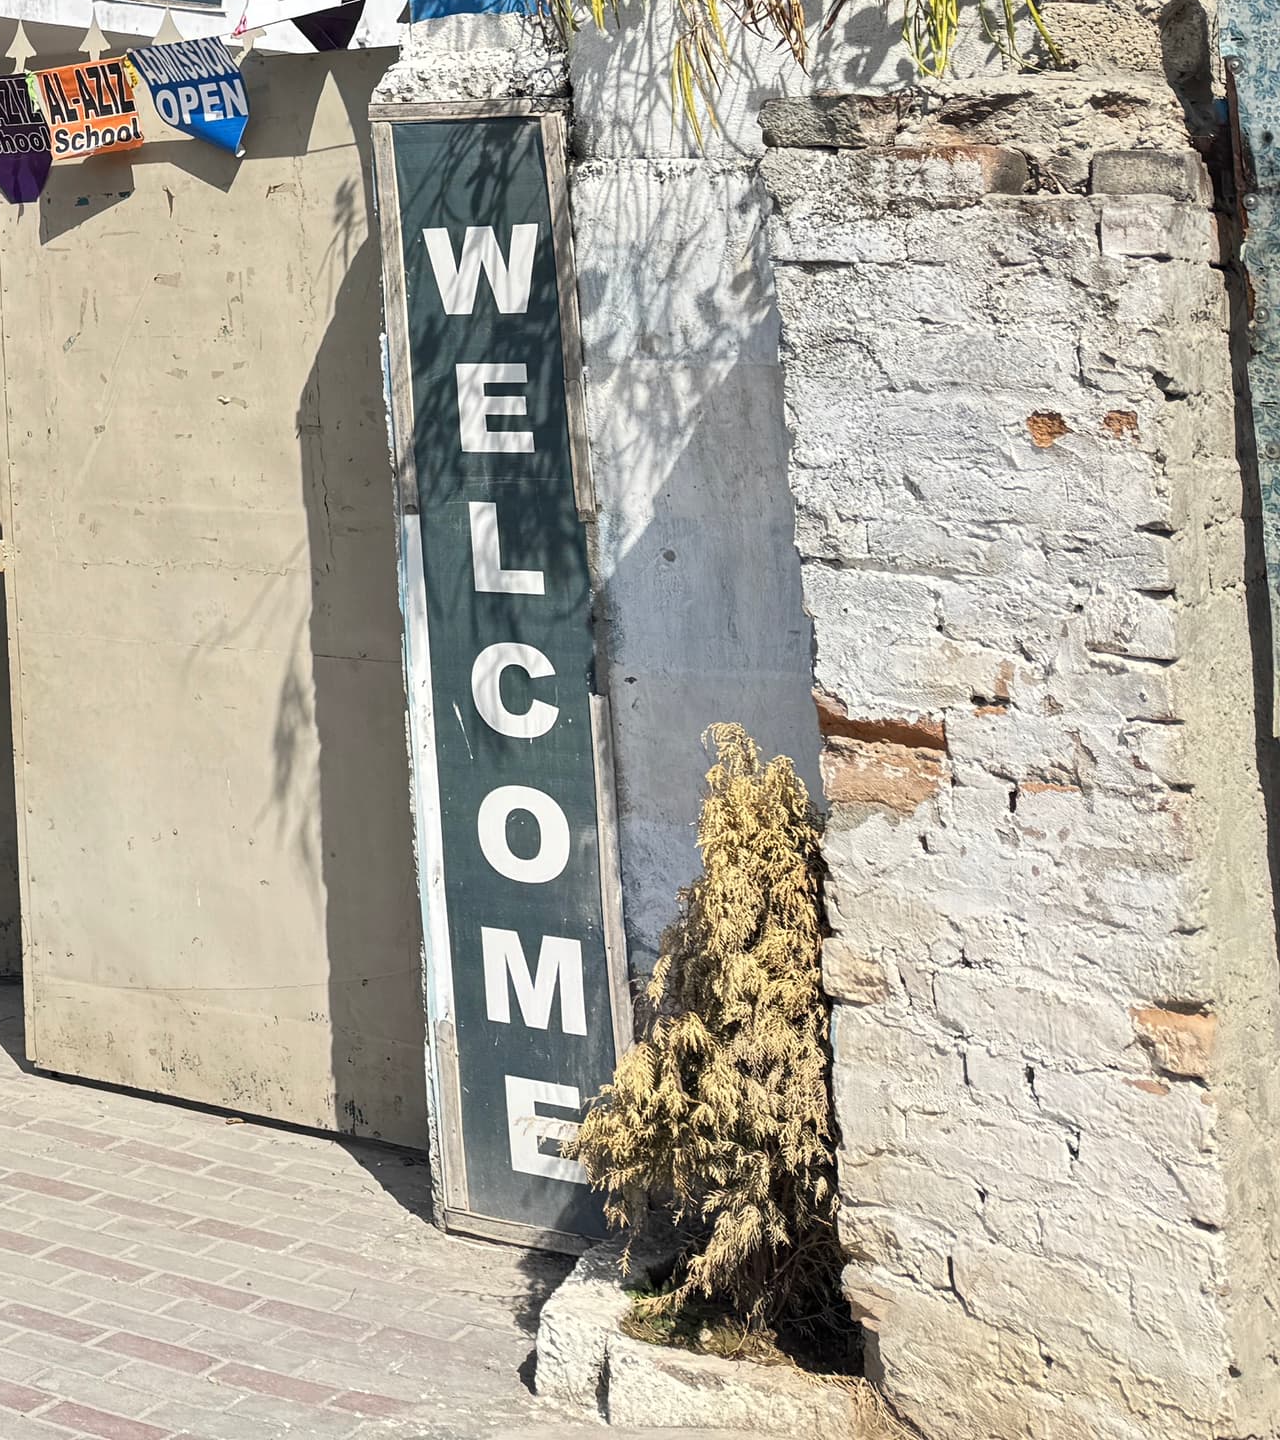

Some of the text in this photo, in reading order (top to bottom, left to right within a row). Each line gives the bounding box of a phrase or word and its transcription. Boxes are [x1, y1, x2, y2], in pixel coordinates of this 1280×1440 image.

[133, 36, 240, 86] ADMISSION
[42, 62, 136, 126] AL-AZIZ
[155, 78, 250, 127] OPEN
[53, 116, 142, 154] School
[422, 225, 590, 1186] WELCOME
